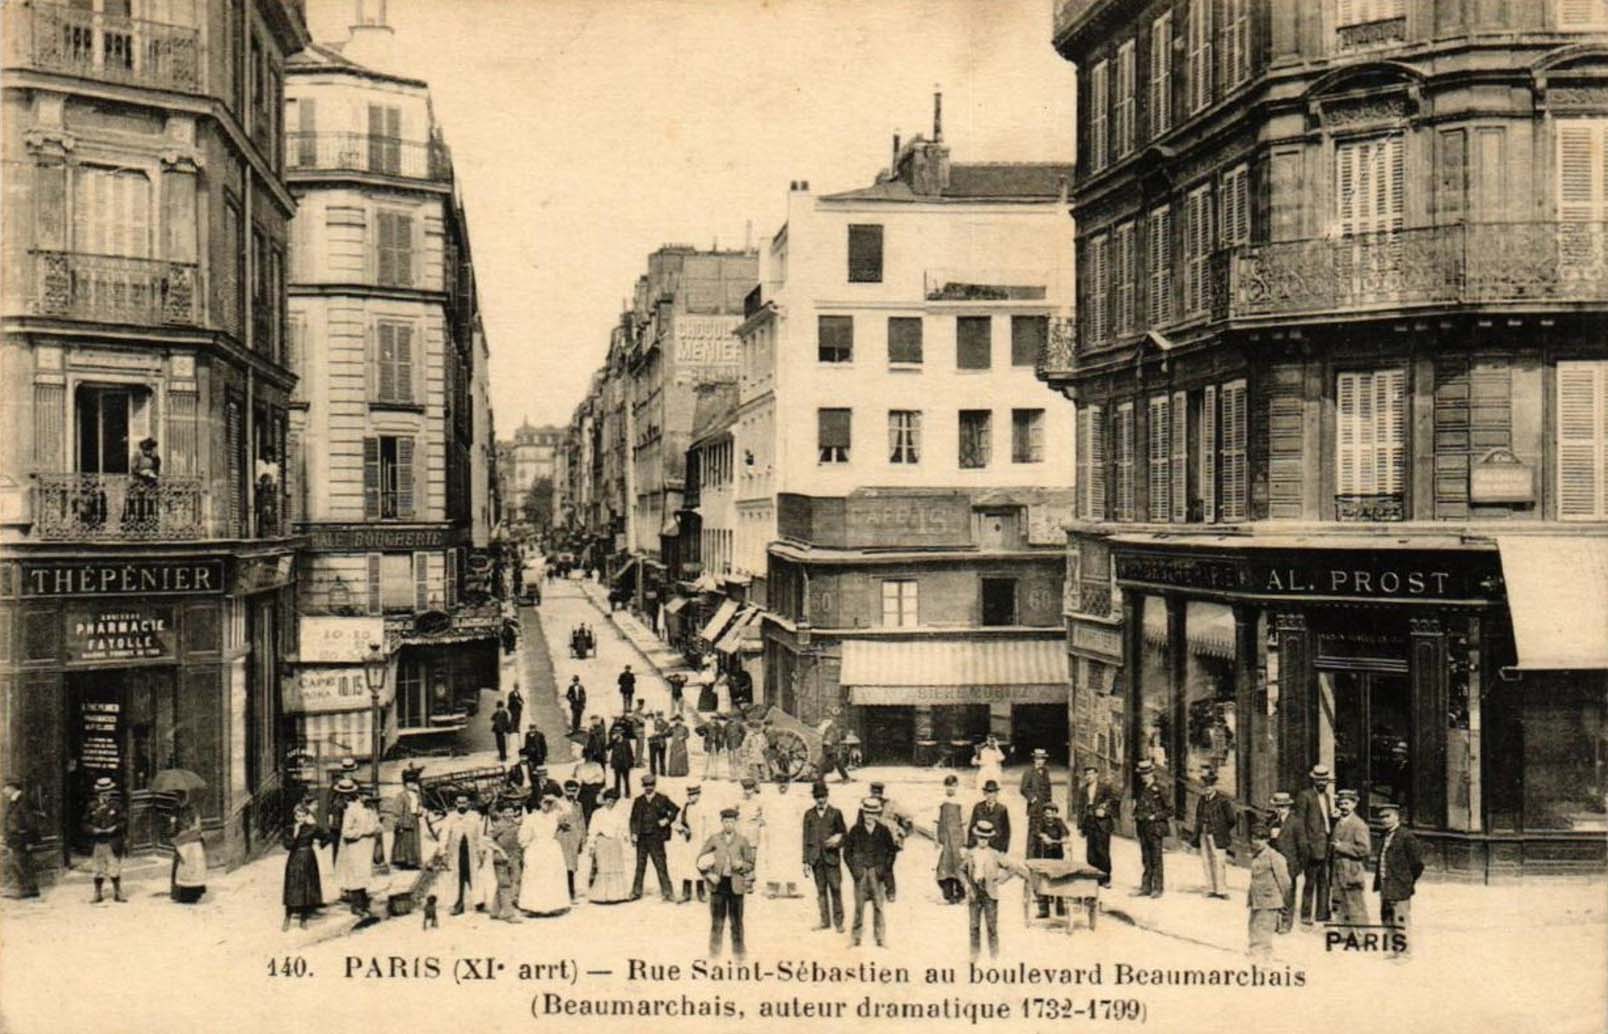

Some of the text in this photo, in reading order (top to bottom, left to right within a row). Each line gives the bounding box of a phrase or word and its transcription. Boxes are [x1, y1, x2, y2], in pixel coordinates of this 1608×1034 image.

[354, 529, 443, 548] BOUCHERIE
[1266, 570, 1316, 591] AL.
[1330, 571, 1450, 595] PROST
[76, 619, 165, 635] PHARMACIE
[88, 636, 153, 650] FAYOLLE
